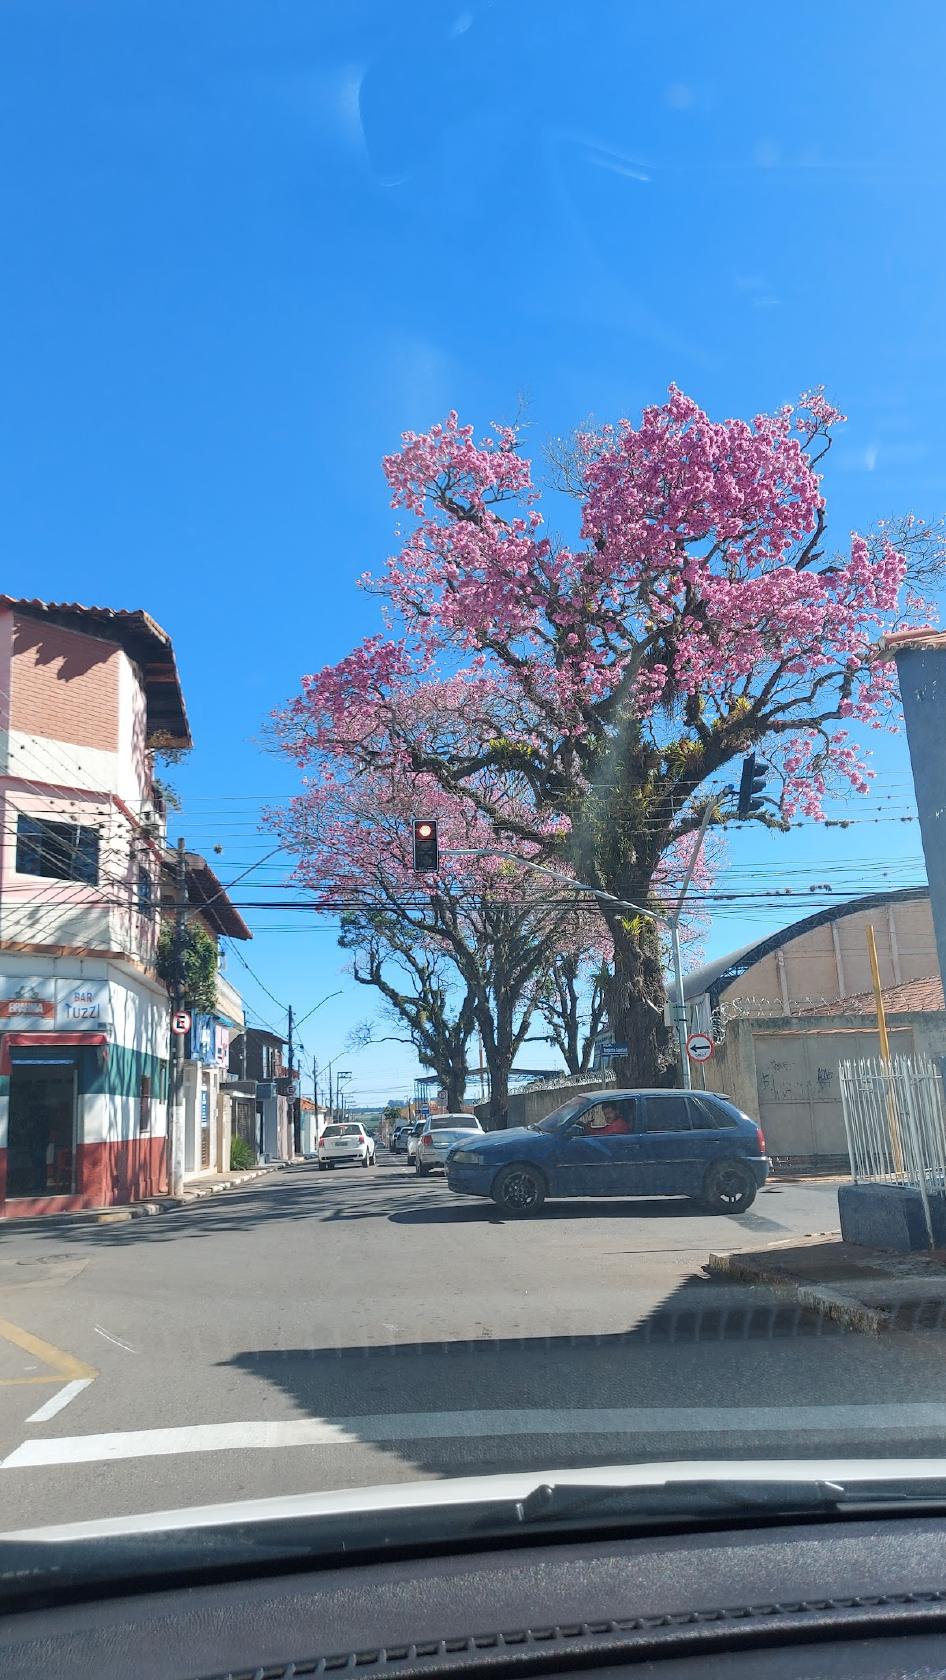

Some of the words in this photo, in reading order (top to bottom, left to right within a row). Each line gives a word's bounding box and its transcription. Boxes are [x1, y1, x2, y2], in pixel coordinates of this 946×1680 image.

[74, 992, 93, 1002] BAR
[64, 1003, 100, 1019] TUZZI
[176, 1015, 186, 1029] E
